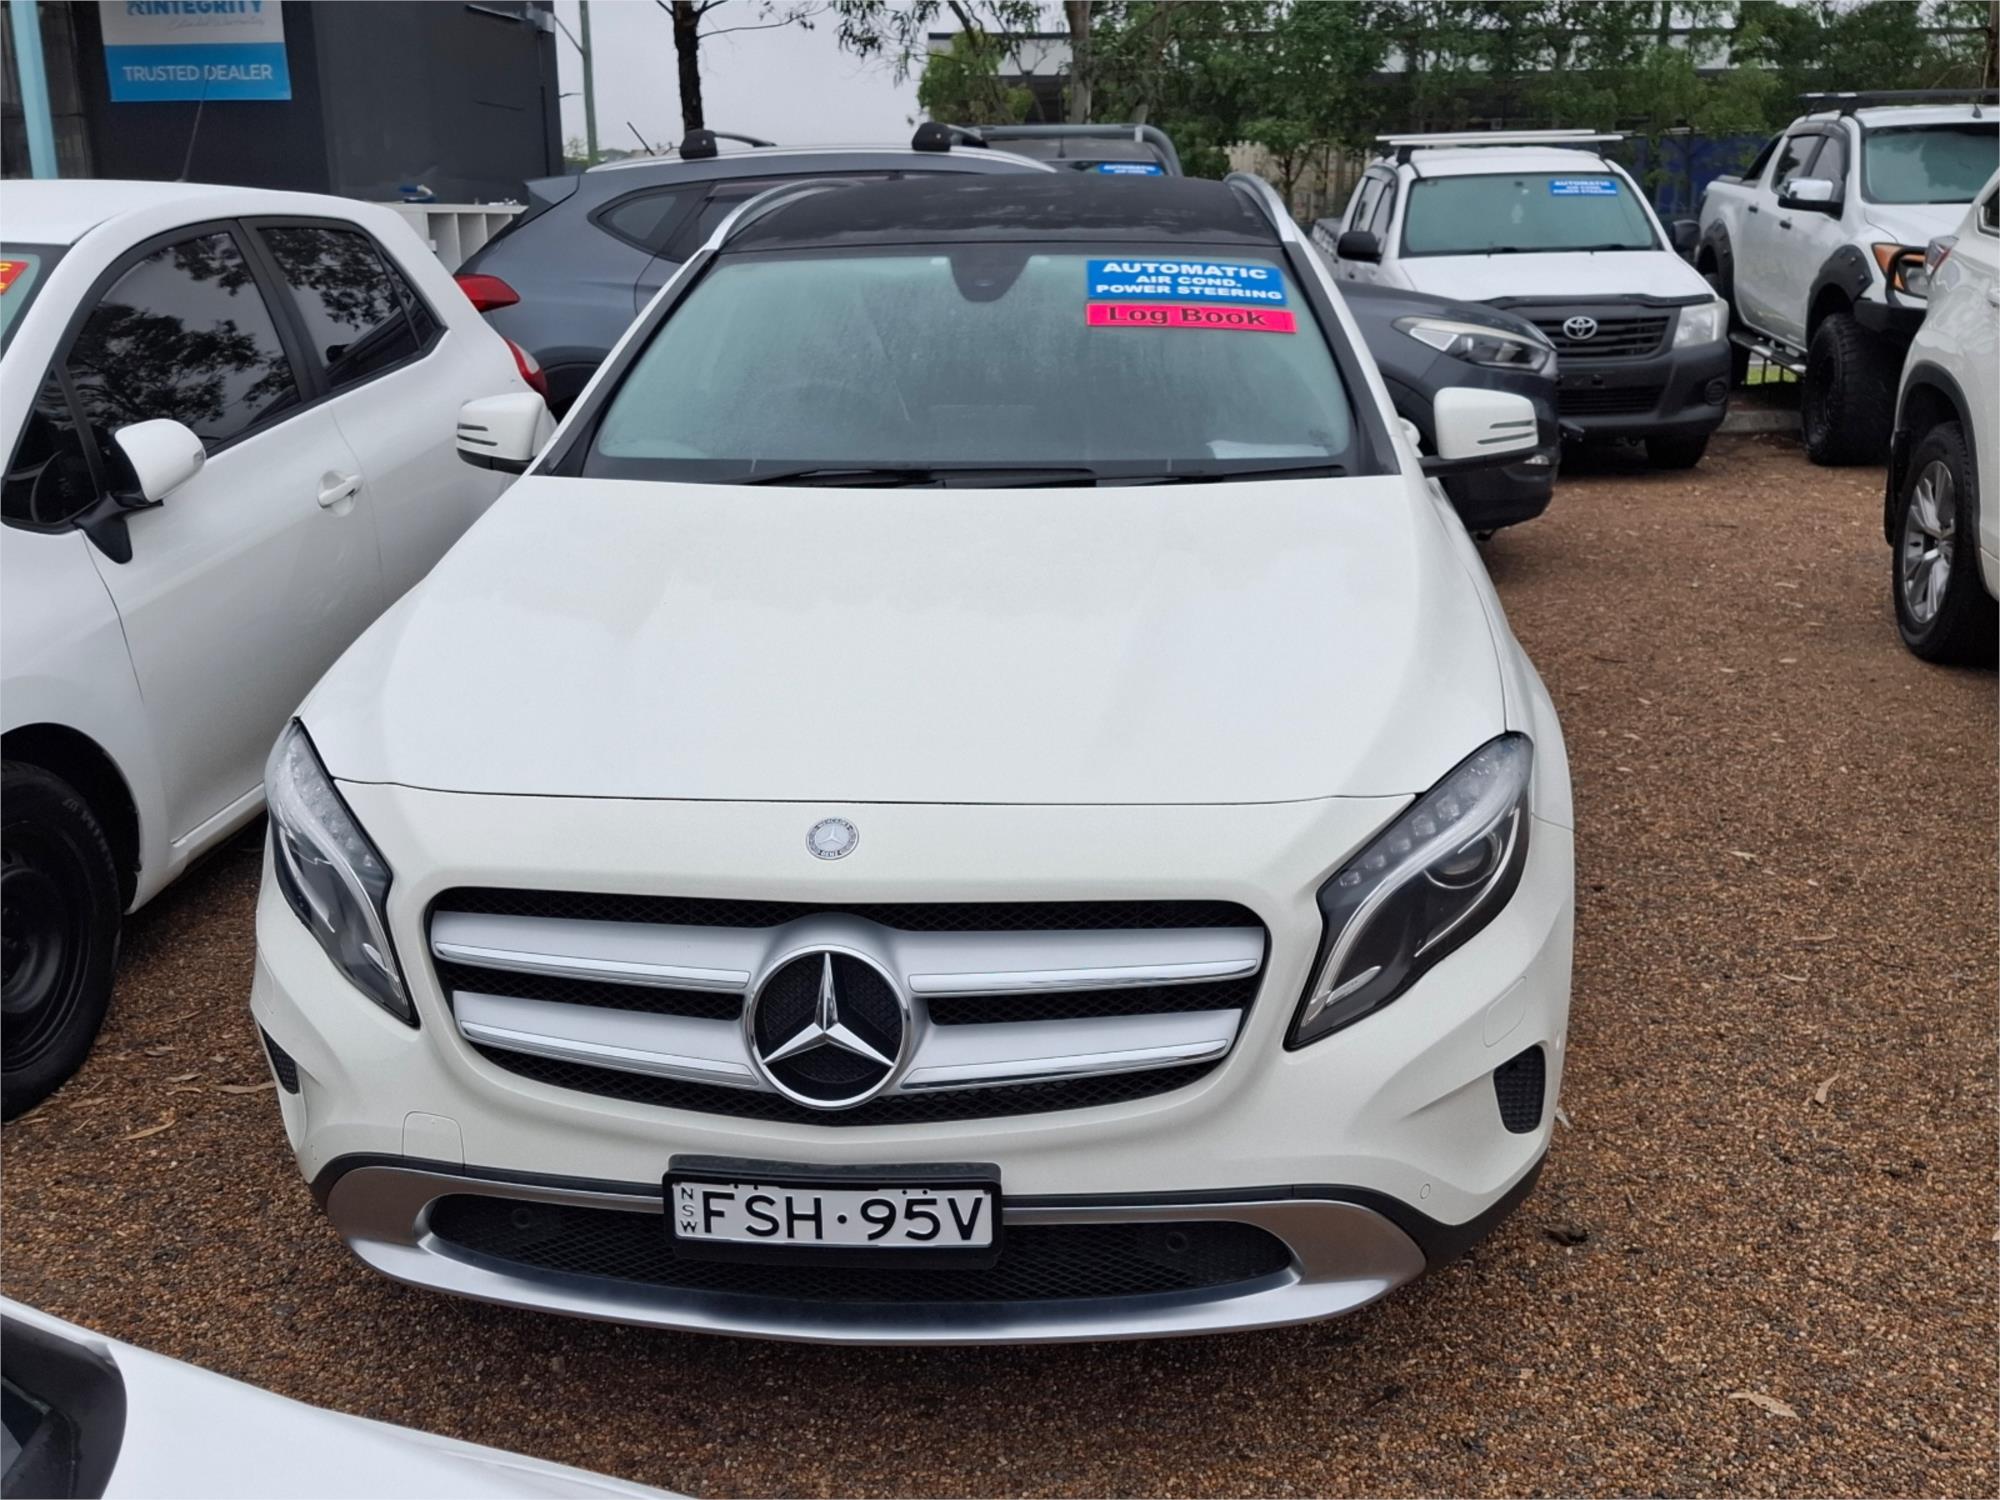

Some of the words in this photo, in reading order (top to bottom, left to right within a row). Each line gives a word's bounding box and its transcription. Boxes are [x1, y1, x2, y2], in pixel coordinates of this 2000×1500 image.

[144, 0, 262, 15] INTEGRITY
[122, 66, 199, 81] TRUSTED
[204, 64, 273, 80] DEALER
[1103, 262, 1268, 279] AUTOMATIC
[1136, 276, 1172, 284] AIR
[1177, 277, 1242, 287] COND.
[1096, 285, 1171, 294] POWER
[1177, 285, 1282, 300] STEERING
[1109, 306, 1168, 324] Log
[1181, 308, 1266, 325] Book
